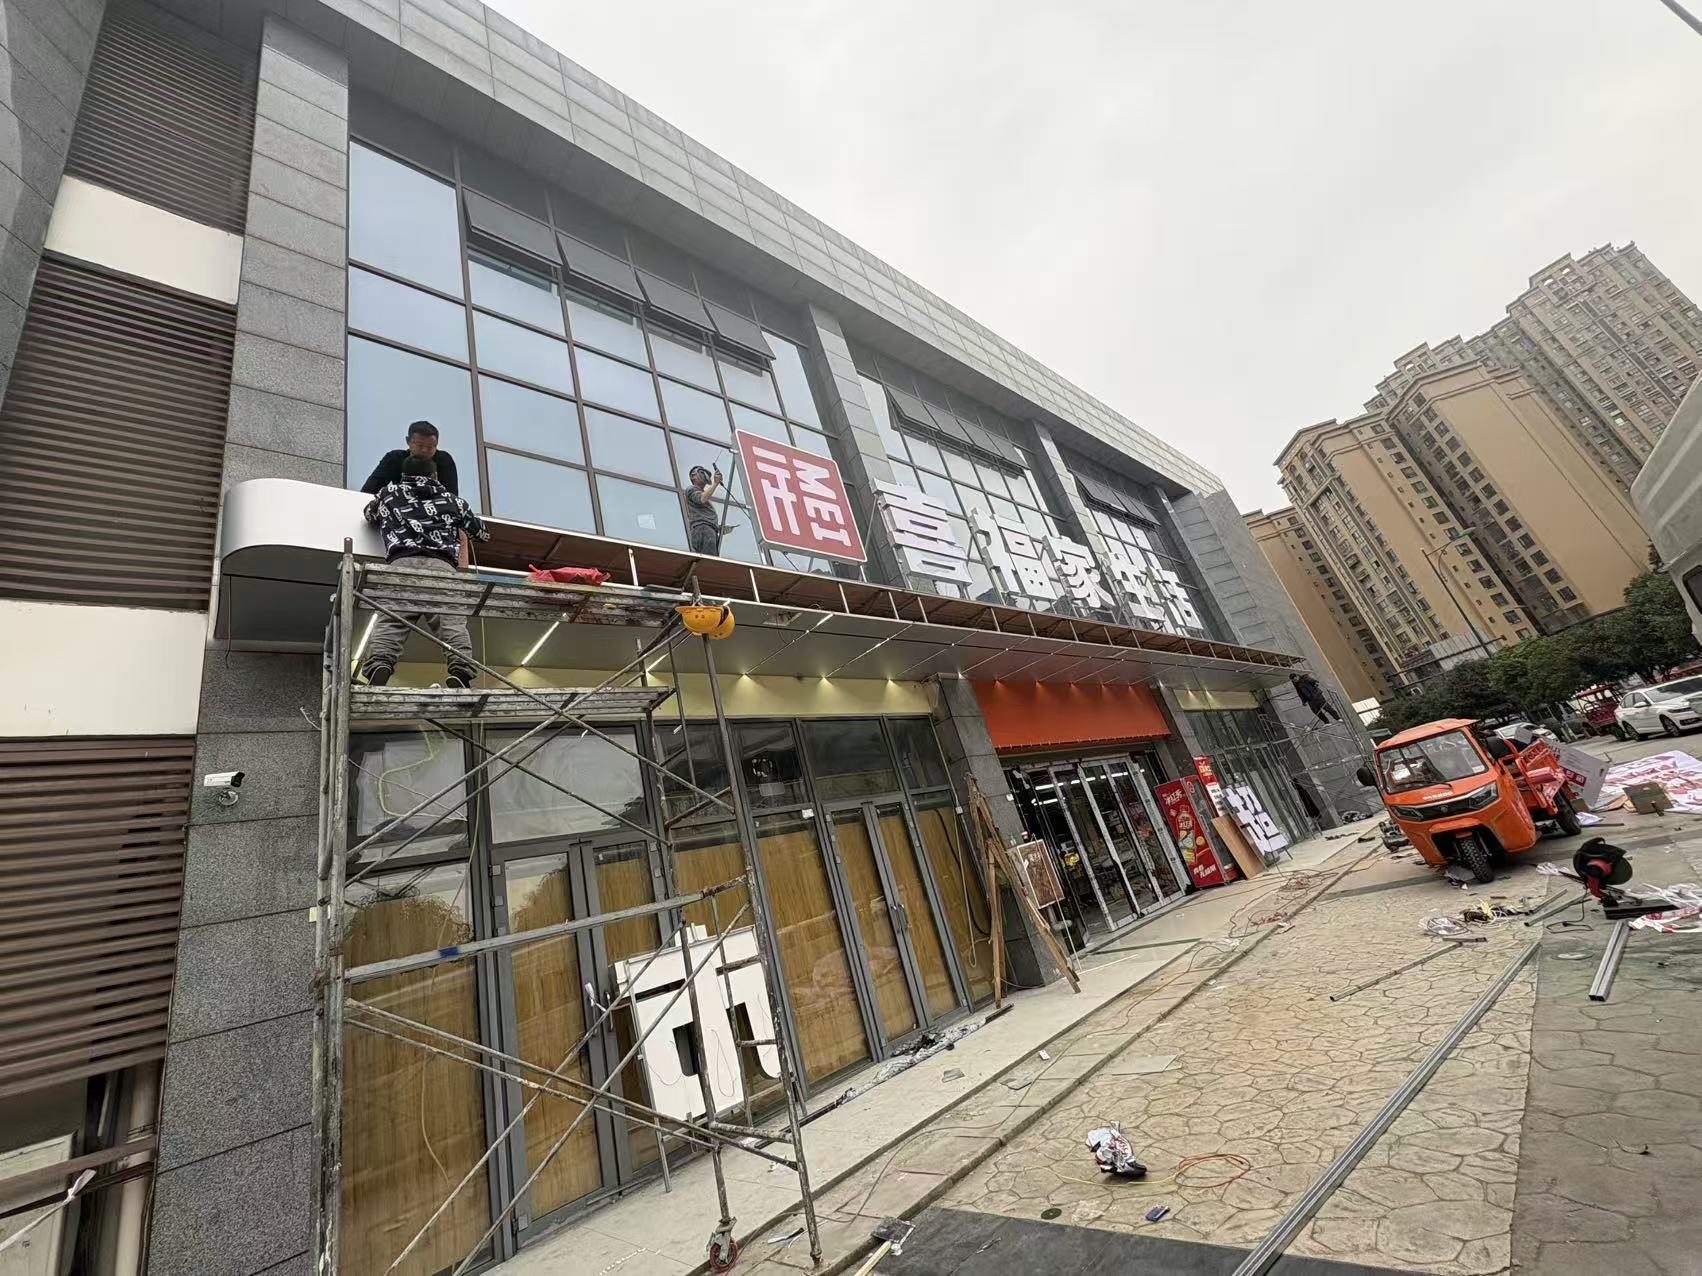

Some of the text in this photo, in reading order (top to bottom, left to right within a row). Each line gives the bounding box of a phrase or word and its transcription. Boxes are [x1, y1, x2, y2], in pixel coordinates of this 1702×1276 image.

[792, 457, 852, 547] MEI
[873, 478, 1205, 631] 喜福家生活
[1224, 784, 1289, 856] 超
[613, 921, 782, 1121] 市
